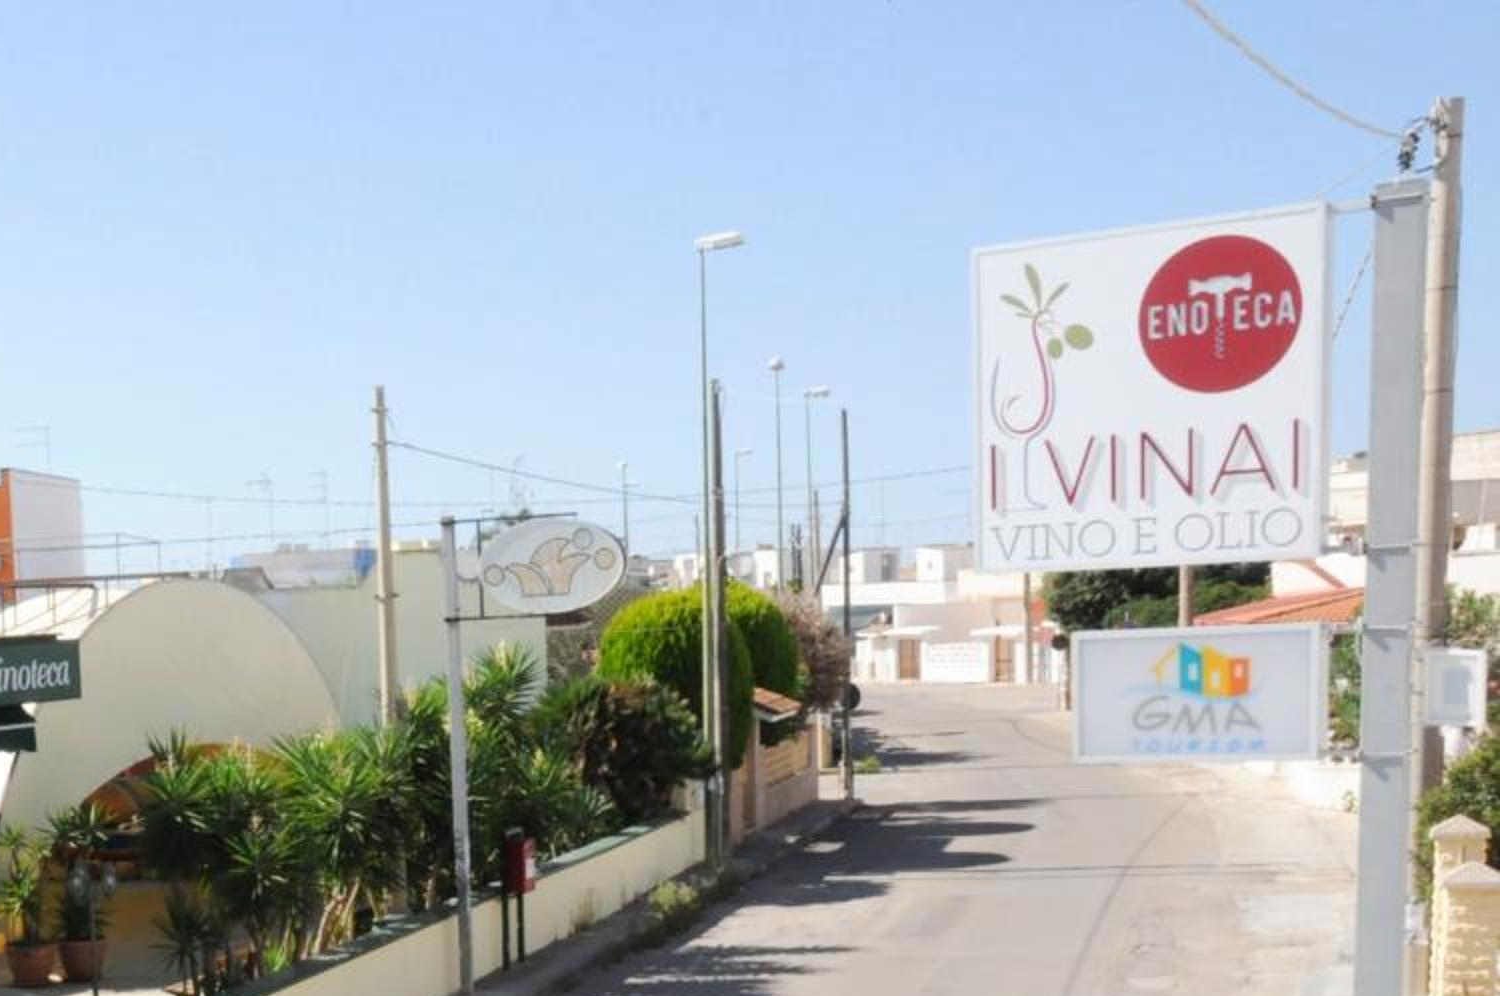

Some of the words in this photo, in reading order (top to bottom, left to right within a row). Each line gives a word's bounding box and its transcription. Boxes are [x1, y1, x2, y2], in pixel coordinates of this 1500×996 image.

[1148, 272, 1297, 340] ENOTECA
[991, 517, 1117, 562] VINO
[1133, 517, 1158, 555] E
[1174, 508, 1303, 554] OLIO
[1132, 695, 1264, 735] GMA
